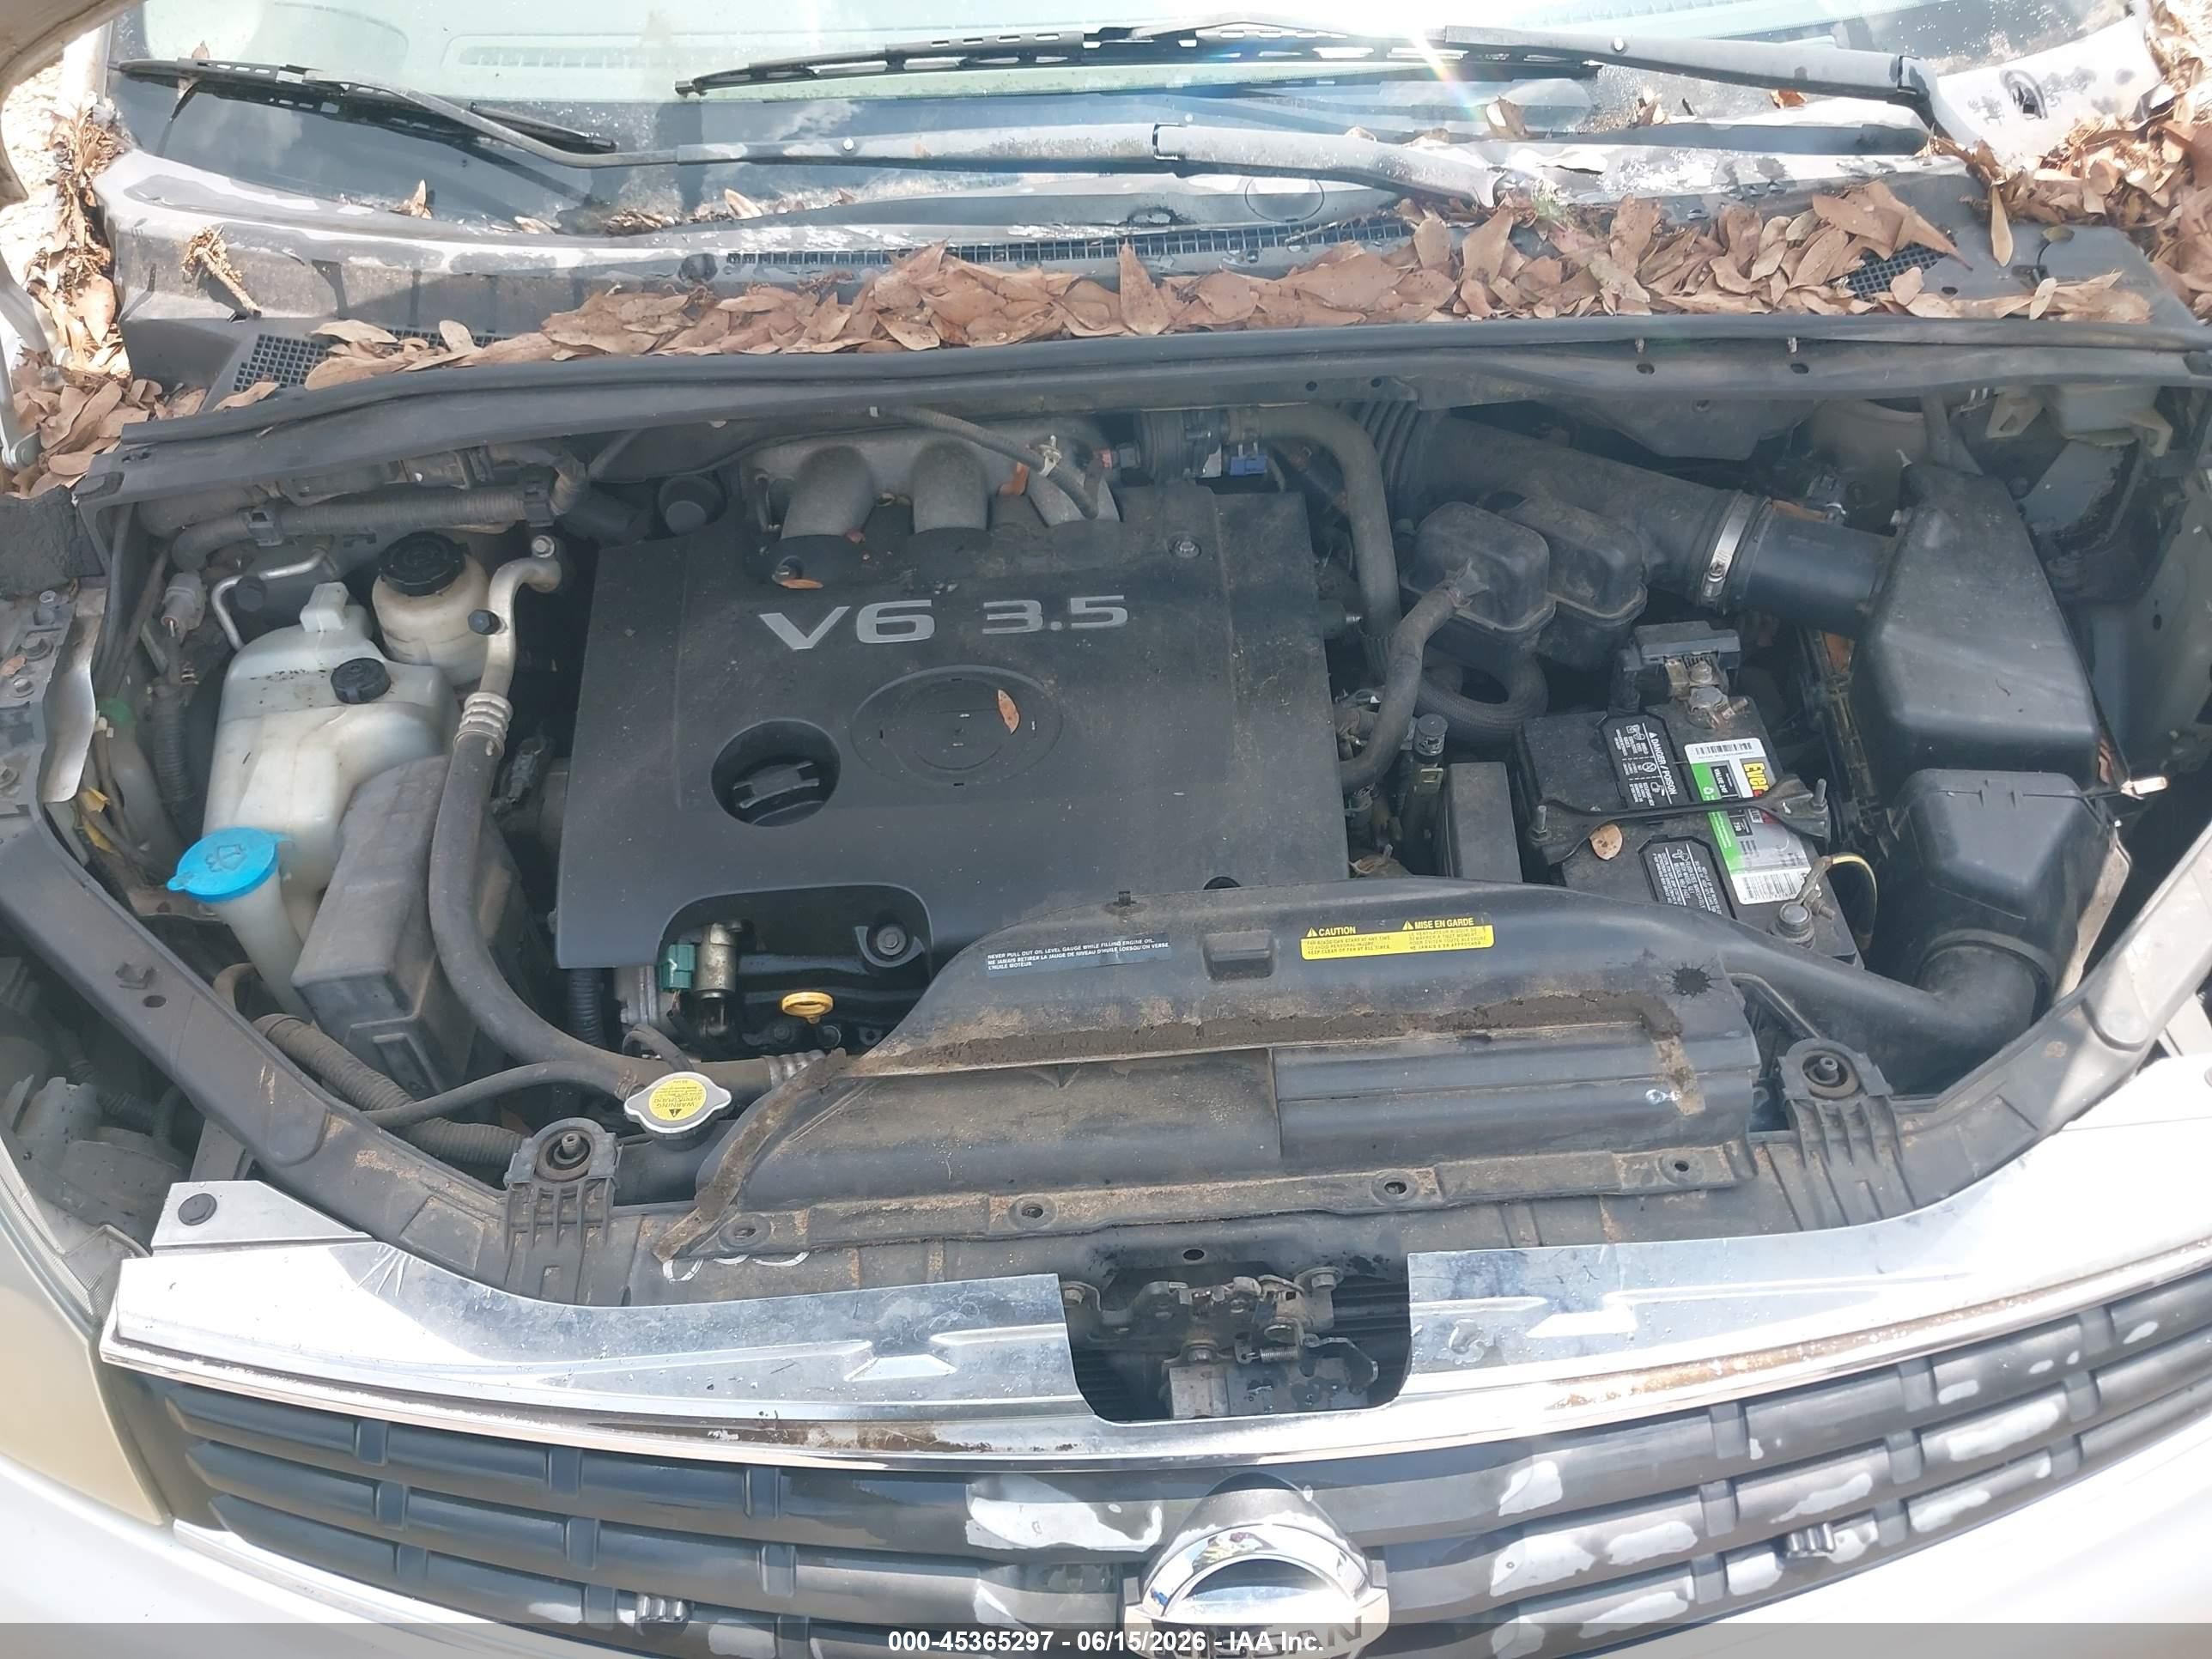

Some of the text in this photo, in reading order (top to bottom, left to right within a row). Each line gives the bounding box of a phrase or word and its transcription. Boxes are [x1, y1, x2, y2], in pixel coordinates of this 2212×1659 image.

[759, 594, 1128, 651] V6 3.5
[1650, 738, 1667, 765] DANGER
[1662, 770, 1678, 795] POISON
[1414, 918, 1474, 930] MISE EN GARDE
[1318, 927, 1357, 937] CAUTION
[1119, 944, 1151, 952] LORSQU'ON
